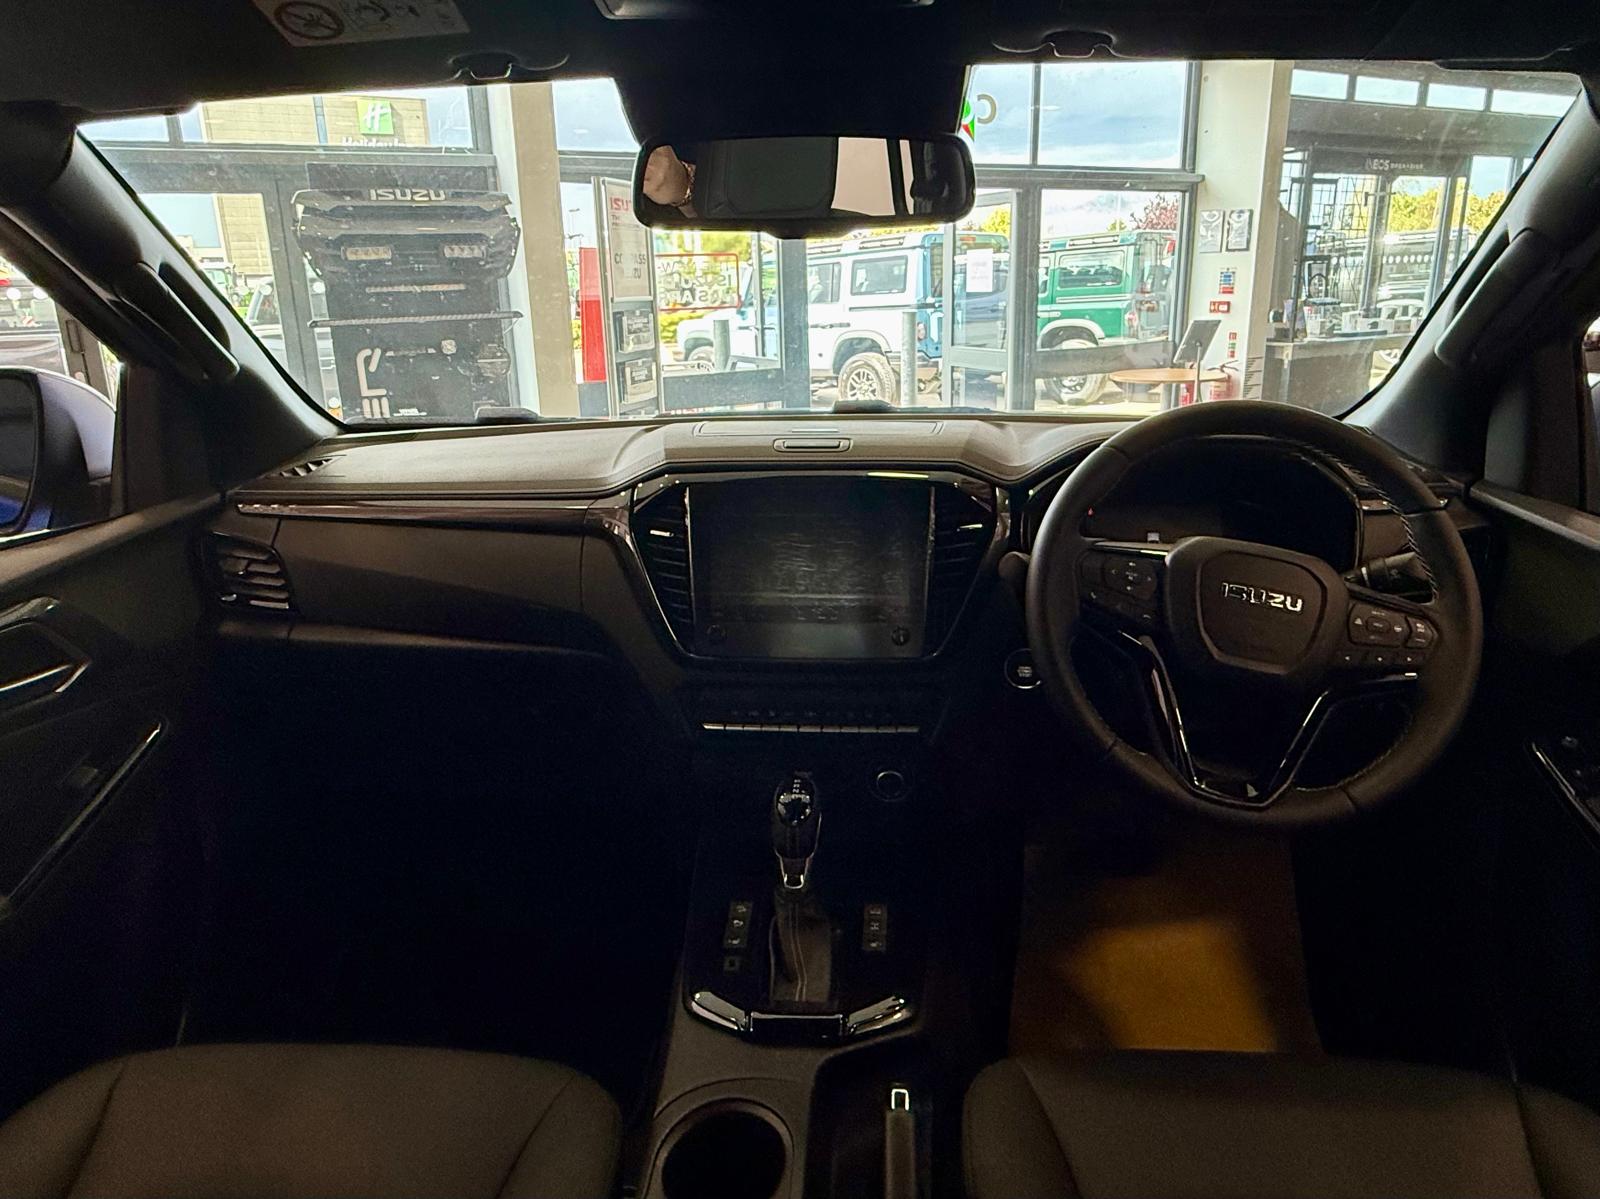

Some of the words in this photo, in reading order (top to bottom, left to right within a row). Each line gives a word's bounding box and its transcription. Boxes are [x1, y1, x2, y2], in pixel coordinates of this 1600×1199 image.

[369, 188, 446, 201] ISUZU
[609, 197, 631, 212] ISU
[1222, 582, 1303, 612] ISUZU
